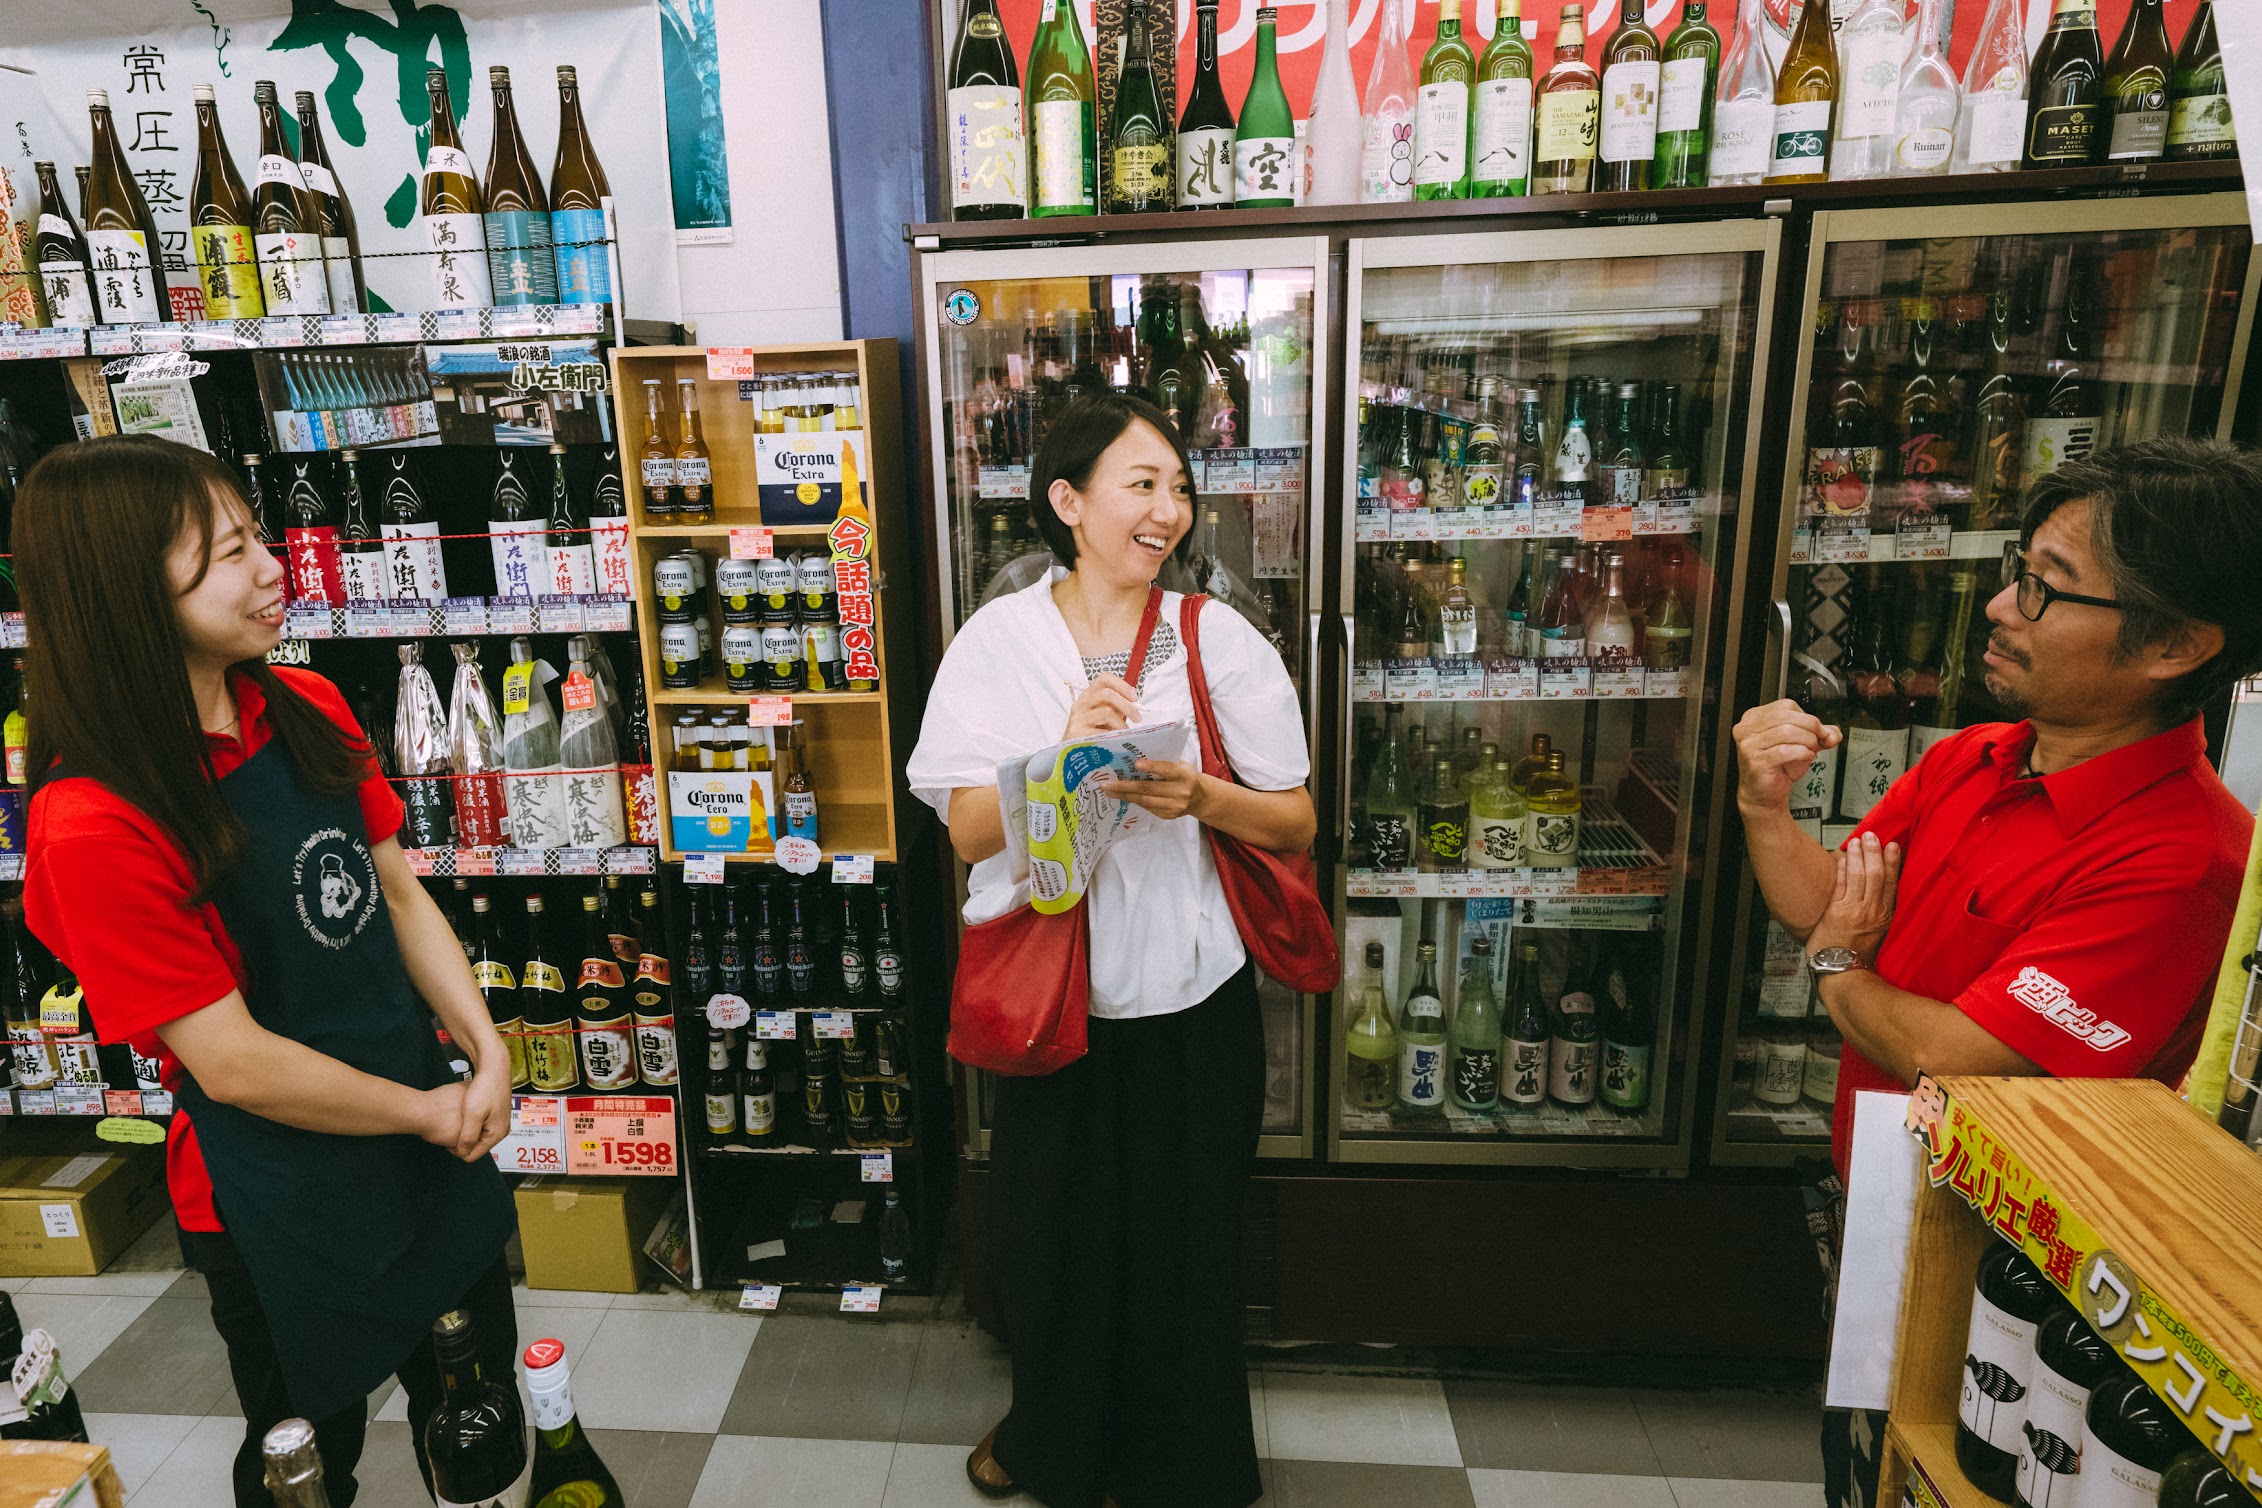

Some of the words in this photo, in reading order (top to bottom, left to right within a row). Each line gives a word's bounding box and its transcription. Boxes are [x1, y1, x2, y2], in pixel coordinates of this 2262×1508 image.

[1434, 111, 1458, 124] 甲州
[1611, 121, 1633, 129] HANDS
[2047, 124, 2094, 135] MASET
[1913, 142, 1945, 152] Ruinart
[261, 162, 282, 171] 辛口
[1249, 142, 1286, 191] 空
[202, 233, 240, 300] 浦霞
[509, 259, 533, 295] 立山
[569, 257, 590, 293] 立山
[513, 364, 606, 391] 小左衛門
[642, 460, 674, 471] Corona
[676, 460, 707, 470] Corona
[775, 451, 837, 472] Corona
[1810, 449, 1873, 487] FRAISE
[792, 468, 825, 480] Extra
[1010, 486, 1024, 495] 900
[1234, 482, 1252, 490] 1,900
[1515, 524, 1530, 532] 430
[1638, 522, 1654, 531] 280
[1372, 530, 1386, 538] 528
[1616, 529, 1631, 537] 370
[756, 546, 773, 555] 258
[1844, 551, 1867, 559] 3,630
[1922, 548, 1946, 557] 3,630
[656, 570, 688, 582] Corona
[720, 570, 753, 581] Corona
[759, 569, 791, 580] Corona
[799, 569, 831, 580] Corona
[662, 580, 682, 588] Extra
[727, 580, 748, 588] Extra
[767, 579, 786, 587] Extra
[723, 637, 753, 649] Corona
[765, 637, 797, 649] Corona
[776, 713, 791, 721] 198
[1069, 751, 1090, 776] 8/31
[672, 774, 677, 782] 6
[687, 790, 744, 807] Corona
[785, 794, 812, 804] Corona
[512, 778, 546, 846] 寒中梅
[568, 777, 600, 845] 寒中梅
[706, 805, 728, 814] Cero
[705, 873, 722, 881] 1,198
[588, 1037, 615, 1077] 白雪
[641, 1032, 664, 1074] 白雪
[628, 1119, 644, 1127] 上撰
[628, 1128, 644, 1136] 白雪
[516, 1148, 558, 1164] 2,158
[1952, 1106, 2033, 1196] 安くて旨い!
[1927, 1118, 2077, 1289] ソムリエ厳選
[1985, 1314, 2023, 1339] GALASSO
[2043, 1378, 2082, 1407] GALASSO
